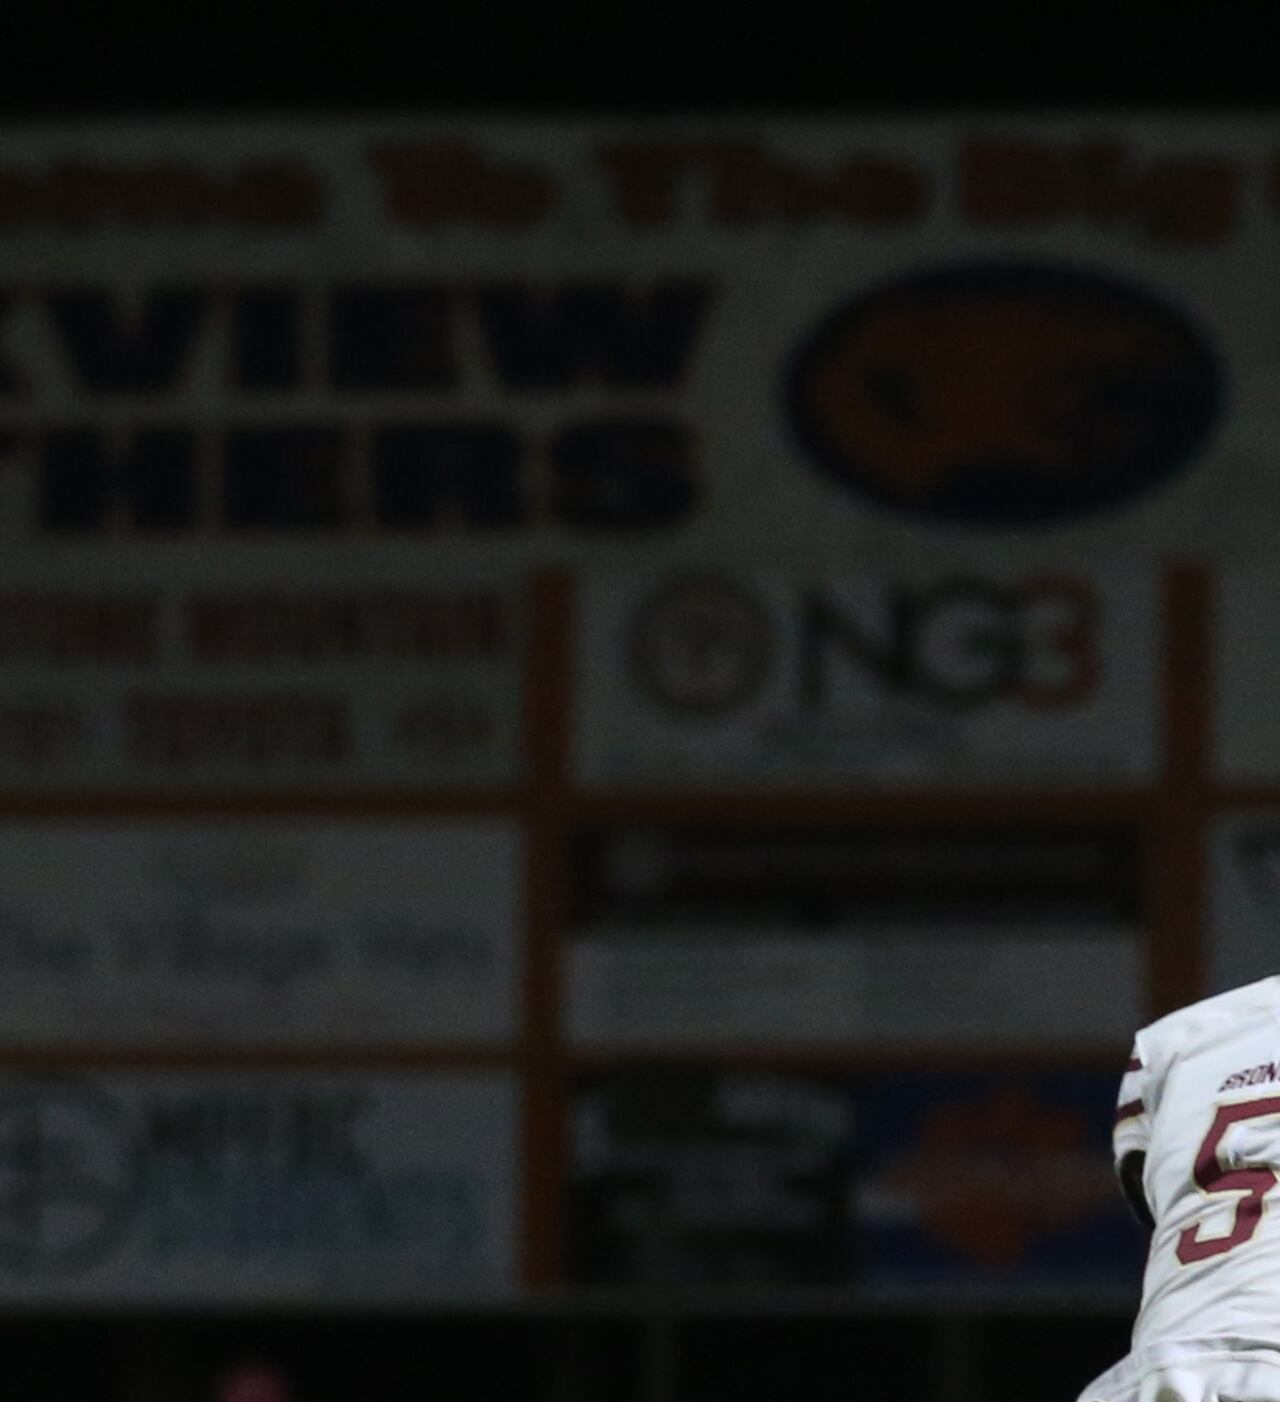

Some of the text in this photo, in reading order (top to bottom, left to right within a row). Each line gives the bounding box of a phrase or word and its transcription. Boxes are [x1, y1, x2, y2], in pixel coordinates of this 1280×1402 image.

[369, 139, 560, 230] To
[598, 139, 928, 230] The
[959, 136, 1241, 250] Big
[0, 284, 711, 389] VIEW
[802, 576, 1099, 707] NG3
